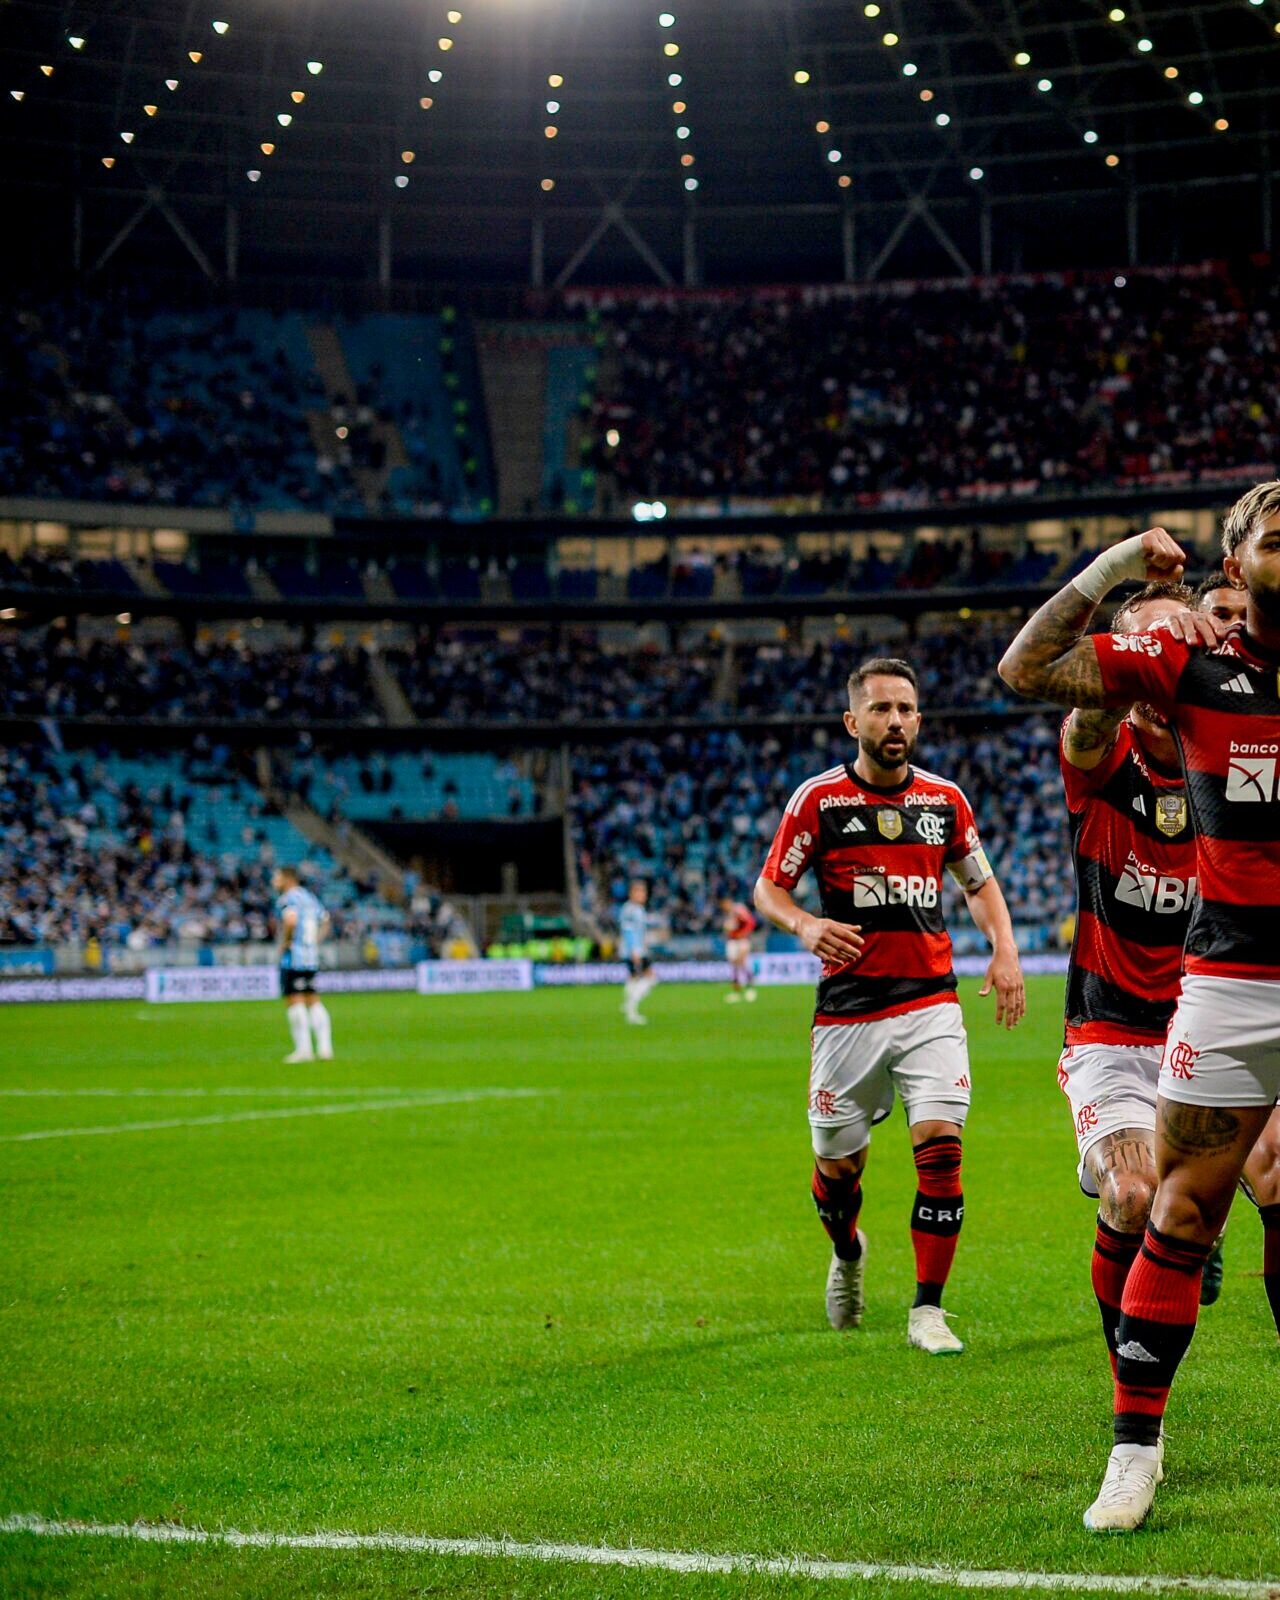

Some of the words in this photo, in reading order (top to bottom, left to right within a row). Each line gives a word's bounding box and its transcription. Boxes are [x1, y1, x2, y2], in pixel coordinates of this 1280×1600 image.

[1229, 740, 1279, 754] banco
[820, 792, 866, 811] pixbet
[904, 792, 948, 808] pixbet
[853, 865, 886, 875] banco
[886, 875, 938, 909] BRB
